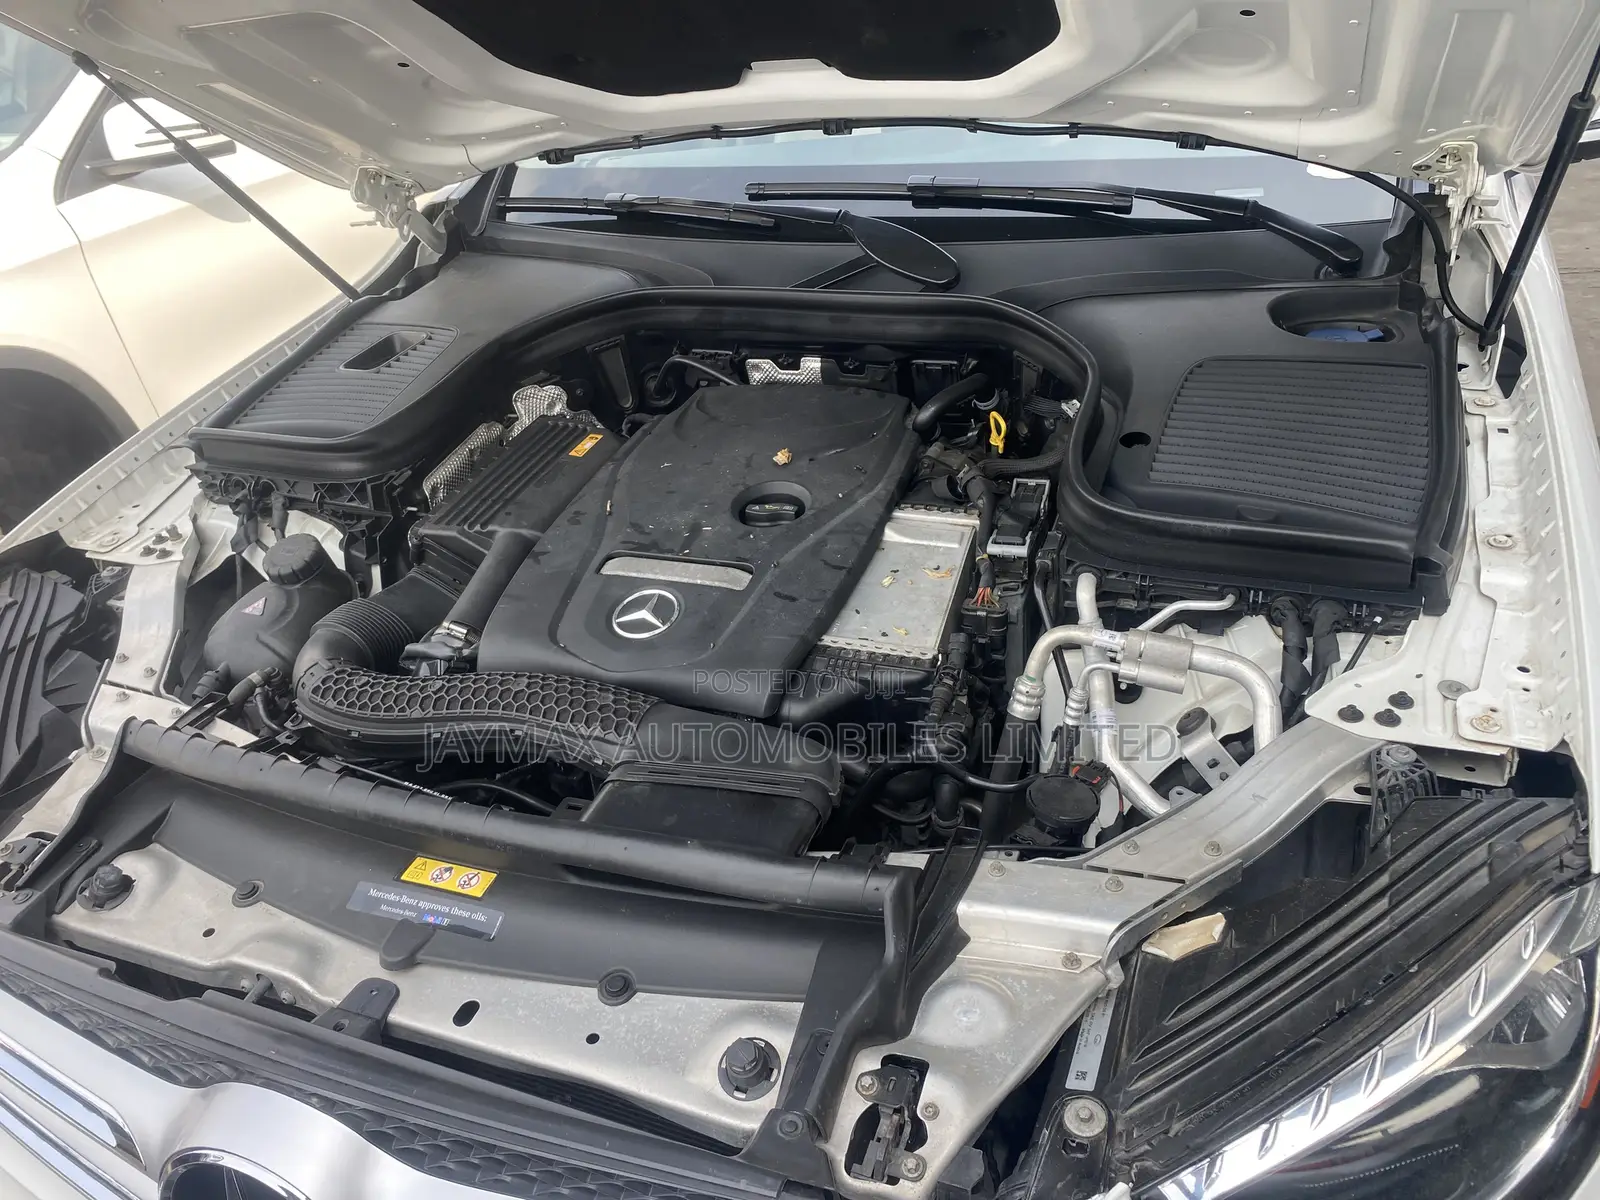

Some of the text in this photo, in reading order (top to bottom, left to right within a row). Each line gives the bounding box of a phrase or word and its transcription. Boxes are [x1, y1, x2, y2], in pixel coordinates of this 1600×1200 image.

[368, 888, 488, 922] Mercedes-Benz approves these oils:
[380, 904, 418, 918] Mercedes-Benz
